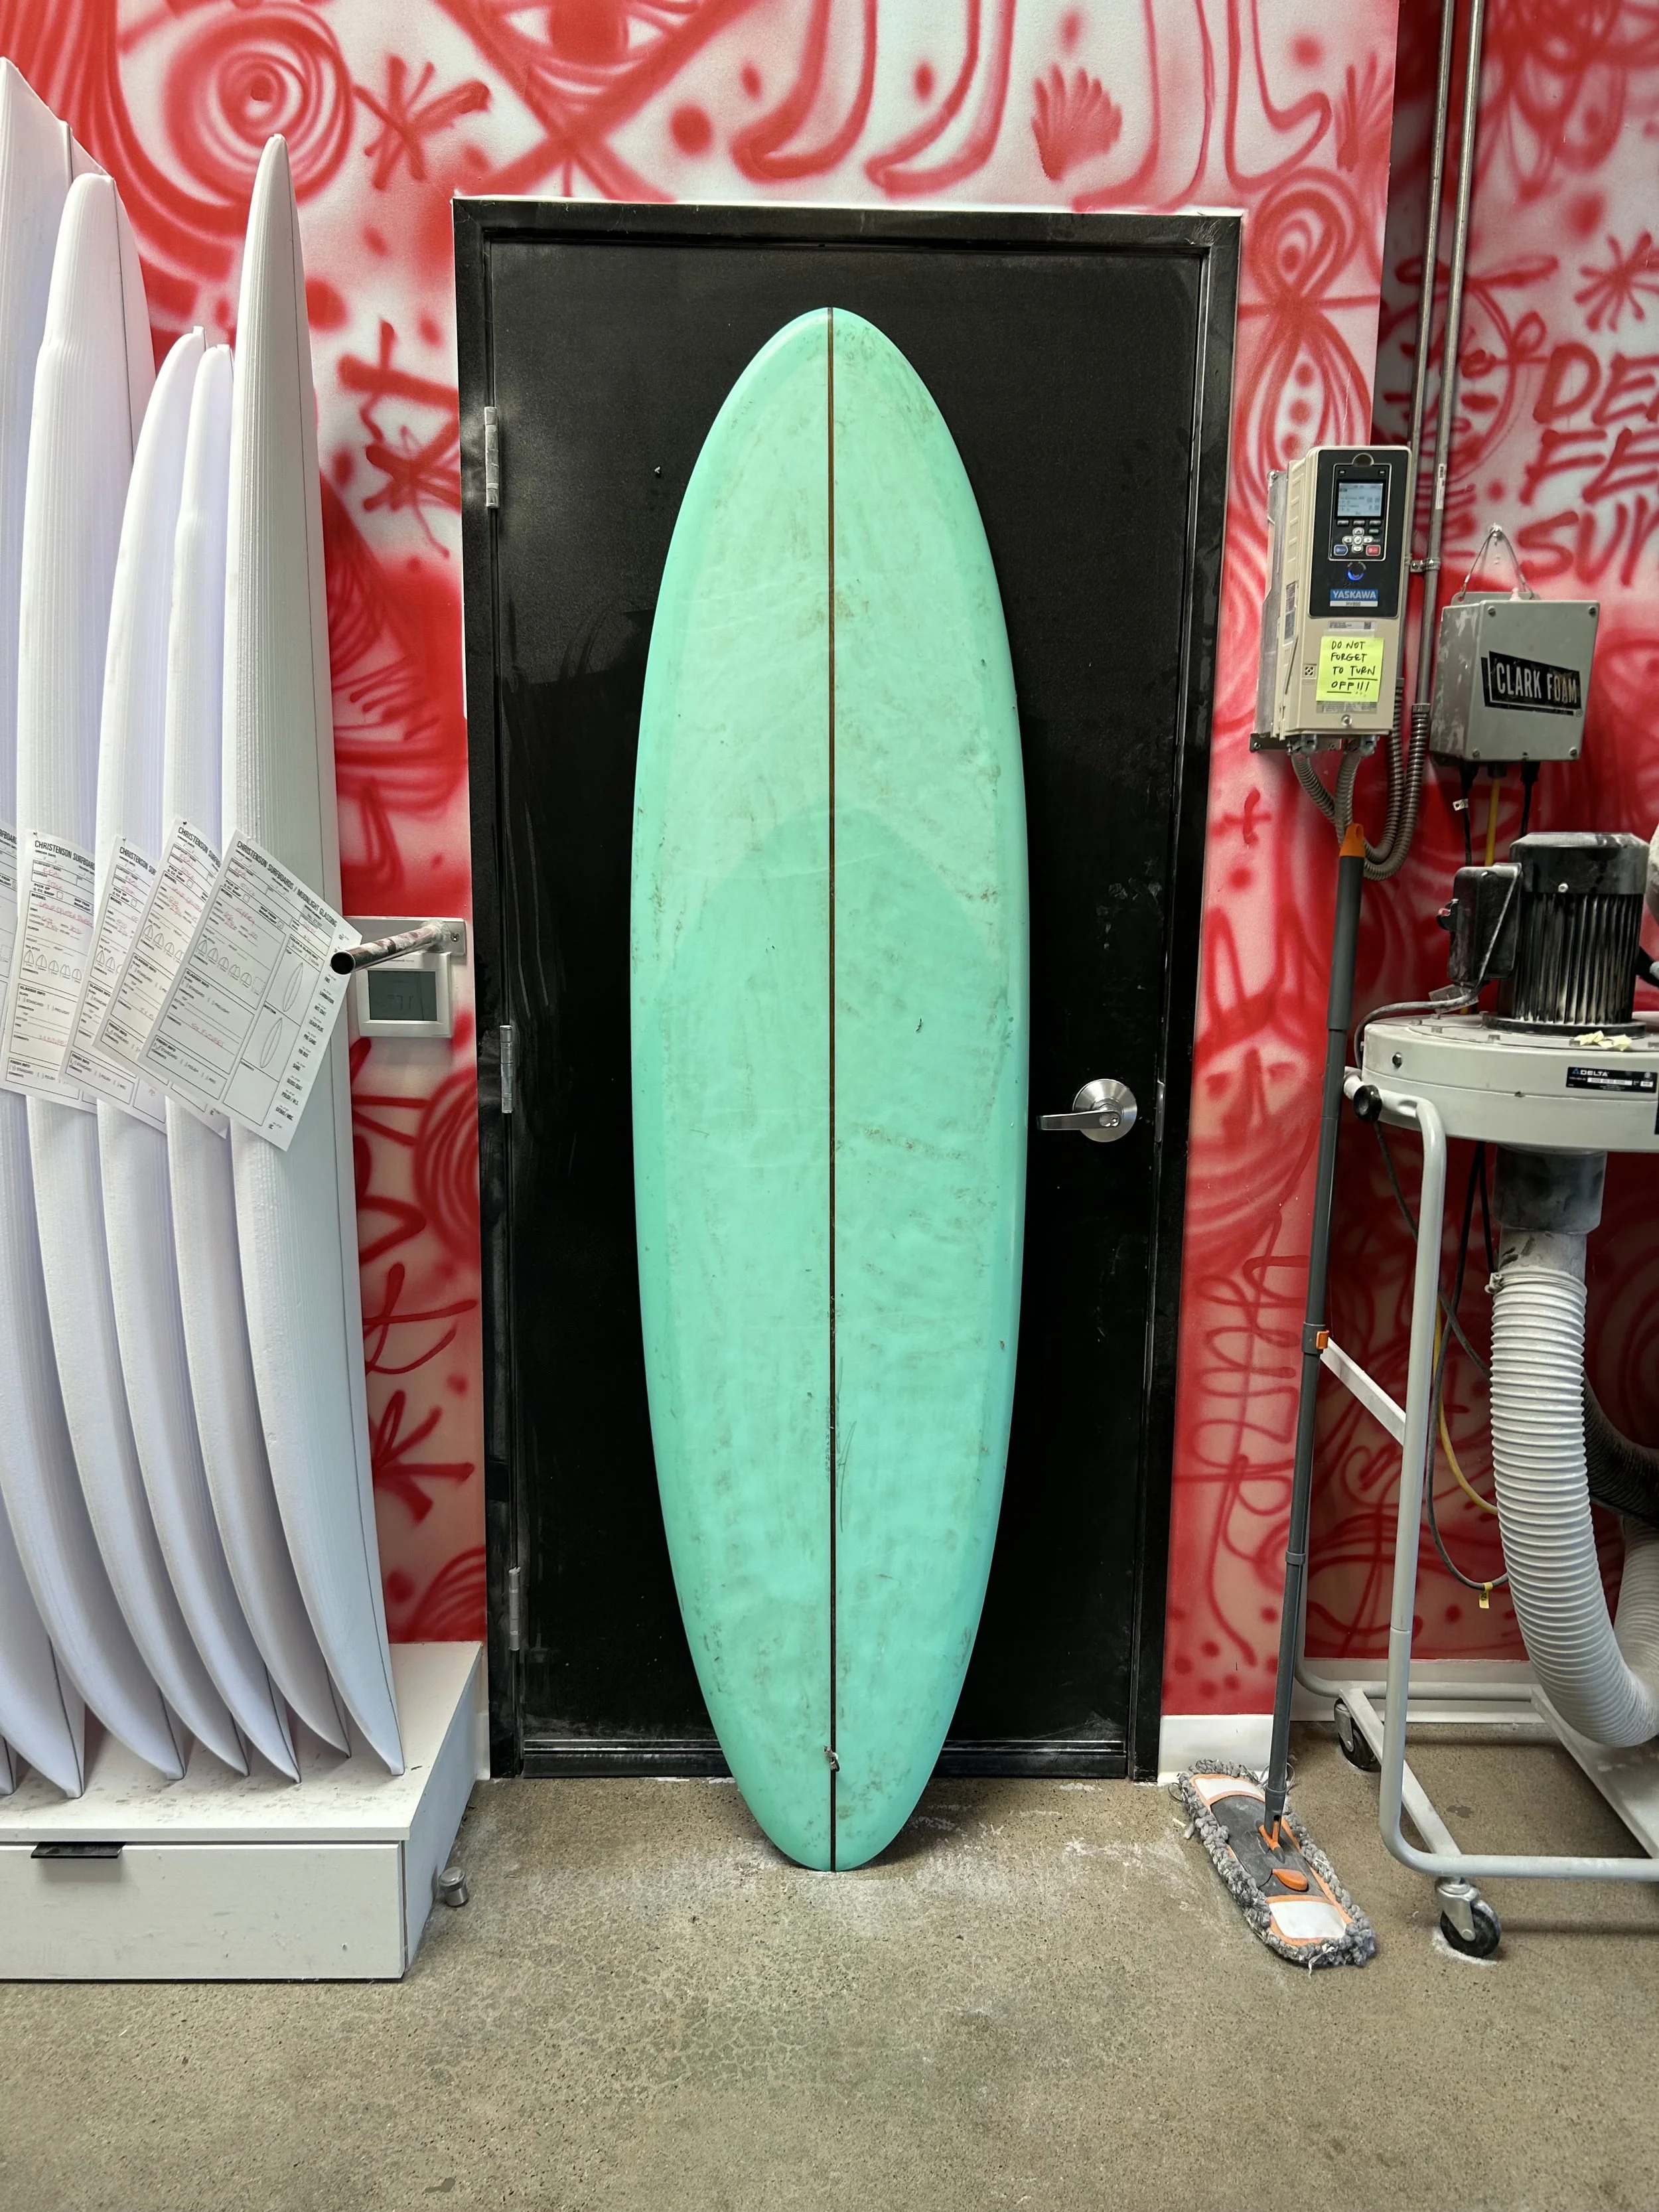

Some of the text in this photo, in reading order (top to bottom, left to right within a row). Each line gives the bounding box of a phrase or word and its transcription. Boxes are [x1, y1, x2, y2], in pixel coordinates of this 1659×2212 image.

[1333, 590, 1376, 599] YASKAWA
[1331, 640, 1366, 650] DO NOT
[1331, 653, 1367, 662] FORGET
[1333, 666, 1376, 676] TO TURN
[1496, 662, 1577, 703] CLARK FOAM
[179, 827, 208, 853] CHRISTENSON
[35, 841, 72, 858] CHRISTENSON
[119, 847, 148, 869] CHRISTENSON
[237, 841, 267, 867] CHRISTENSON
[267, 864, 293, 889] SURFBOARDS
[297, 889, 319, 911] MOONLIGHT
[319, 908, 337, 927] GLASSING
